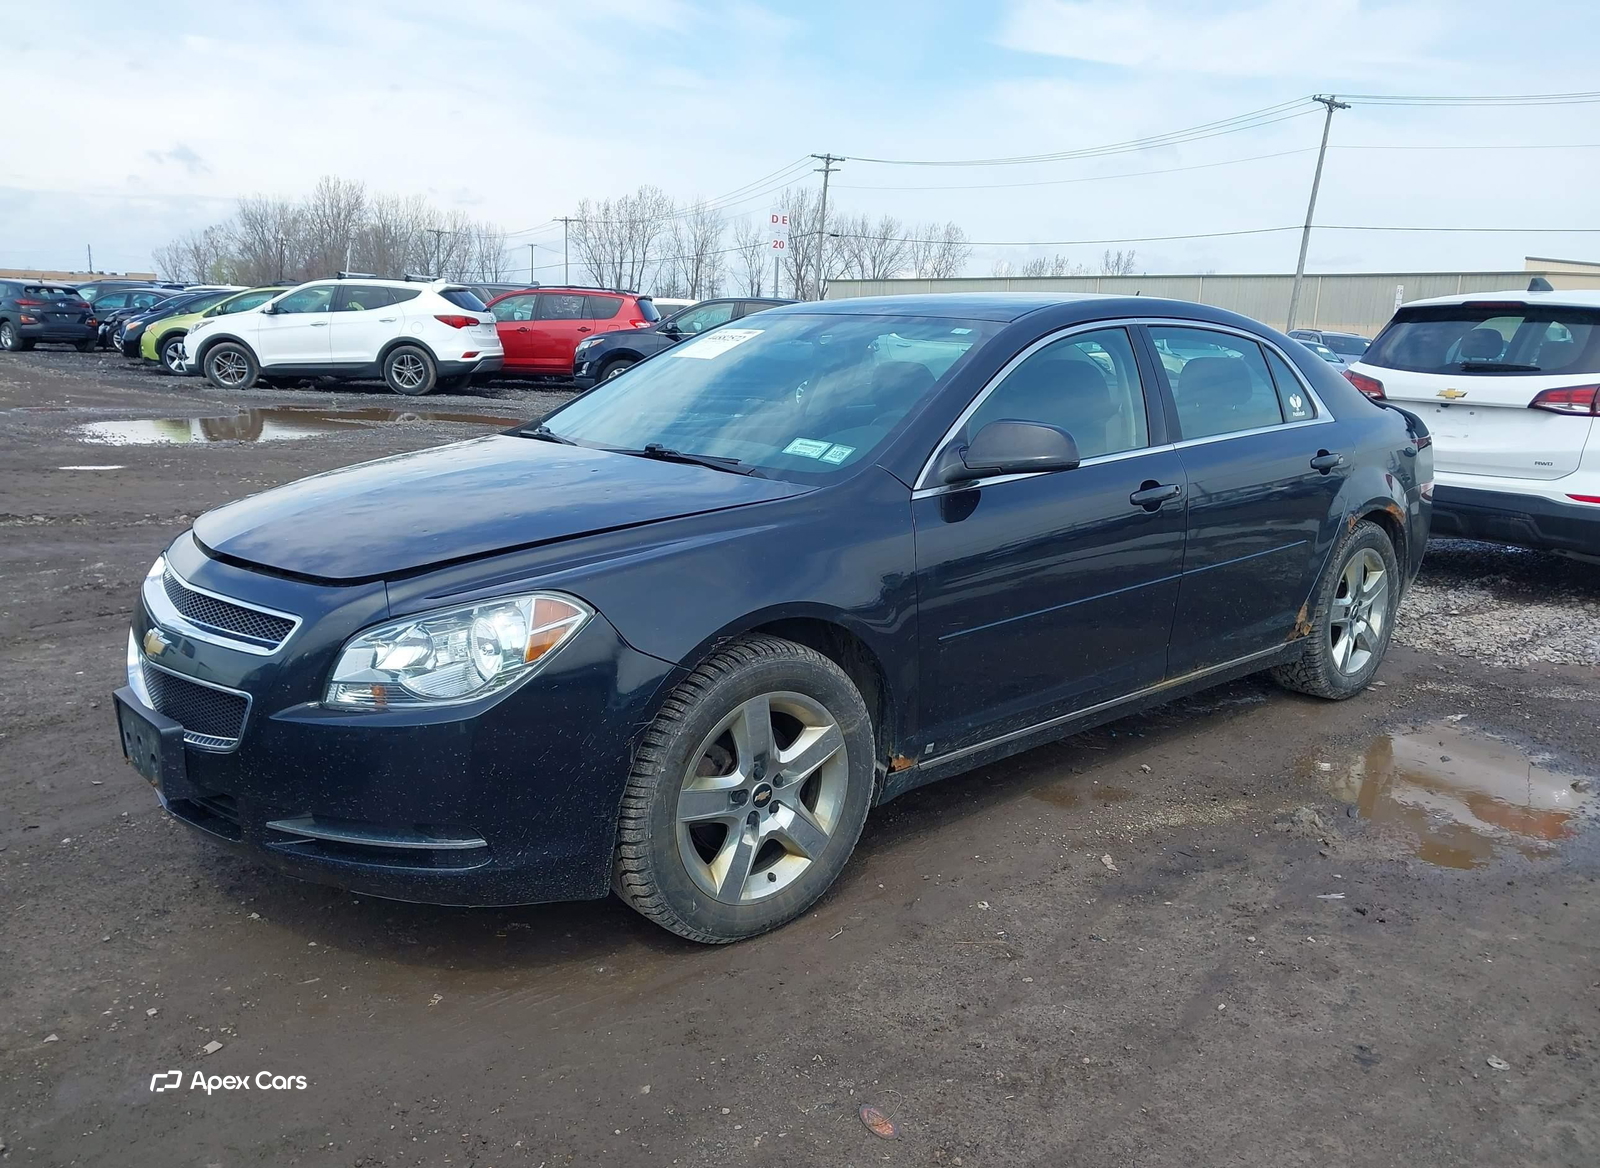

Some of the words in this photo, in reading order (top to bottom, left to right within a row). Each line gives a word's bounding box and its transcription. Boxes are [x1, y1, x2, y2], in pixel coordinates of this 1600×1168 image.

[771, 214, 779, 224] D
[782, 215, 788, 225] E
[772, 239, 785, 249] 20
